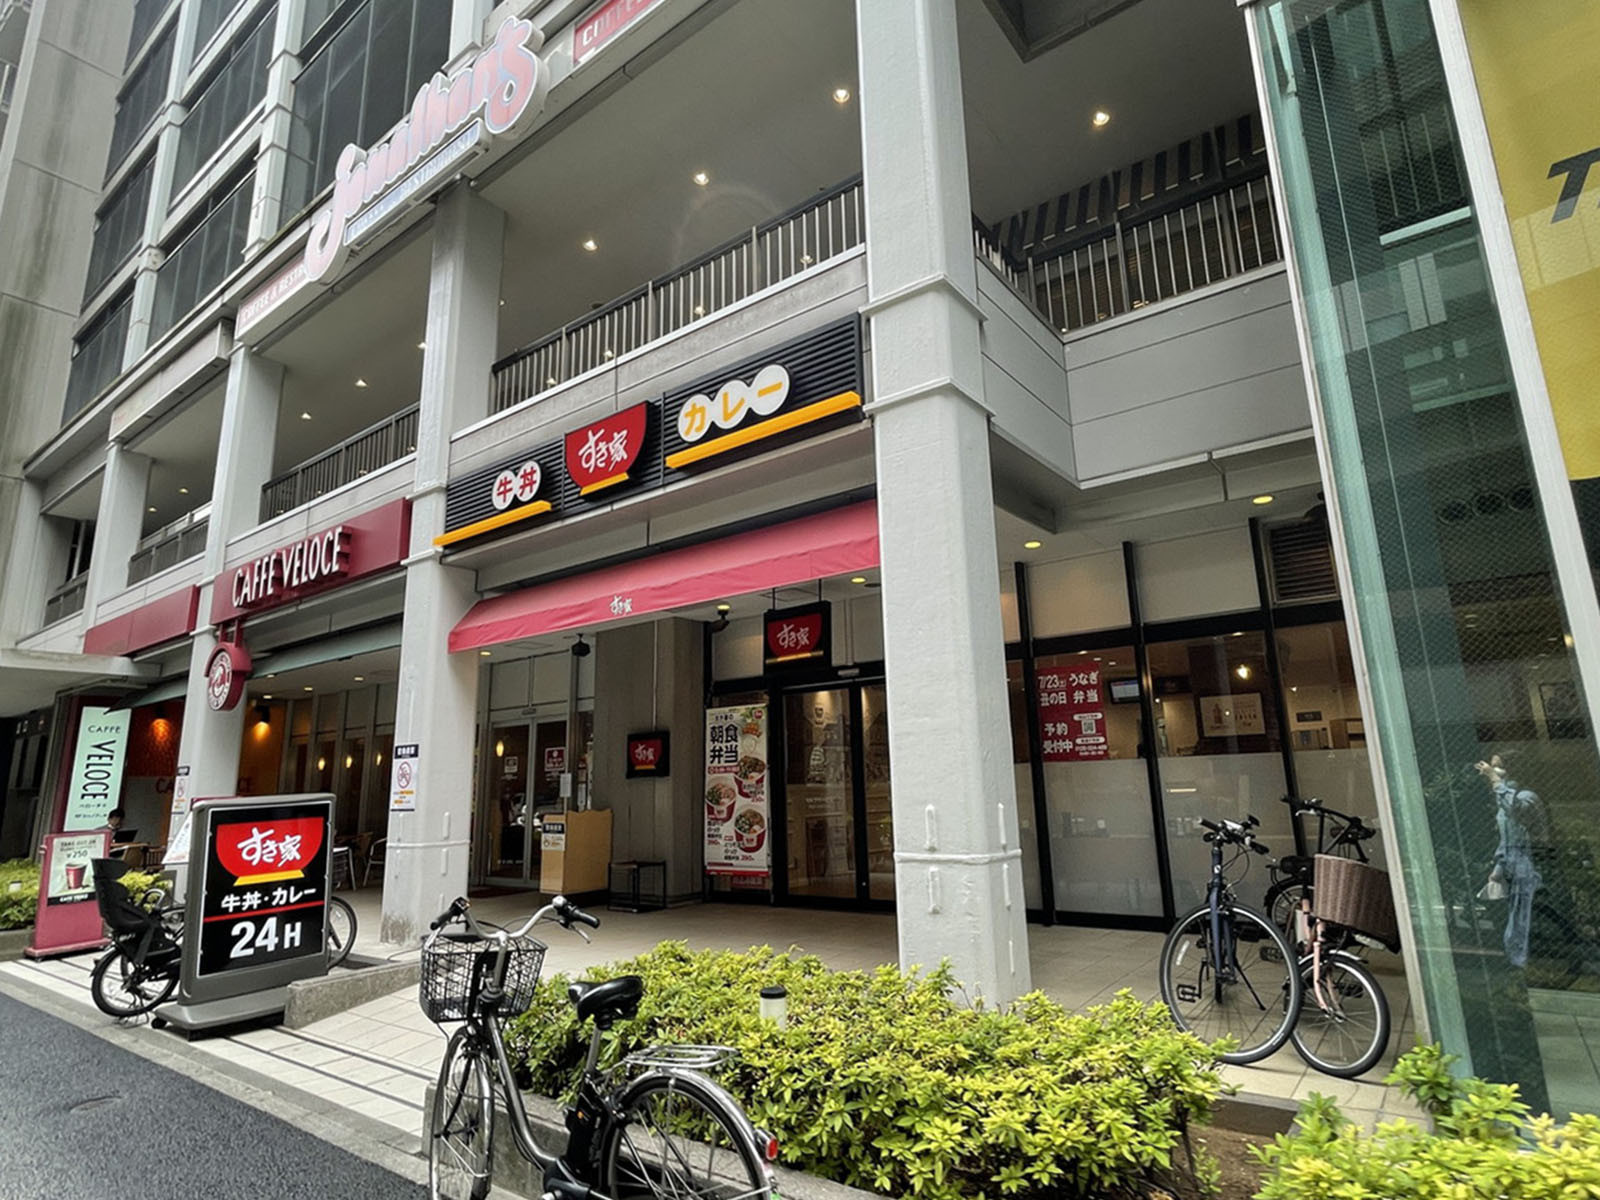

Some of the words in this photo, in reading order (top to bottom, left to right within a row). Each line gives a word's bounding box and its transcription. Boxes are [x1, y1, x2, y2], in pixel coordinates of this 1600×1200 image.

[1546, 147, 1600, 224] T
[684, 380, 783, 436] カレー
[578, 428, 629, 473] すき家
[496, 466, 538, 504] 牛丼
[232, 552, 277, 608] CAFFE
[282, 525, 343, 589] VELOCE
[609, 595, 633, 615] すき家
[777, 623, 811, 651] すき家
[1069, 670, 1099, 687] うなぎ
[1073, 688, 1099, 704] 弁当
[710, 723, 738, 744] 朝食
[1044, 722, 1068, 737] 予約
[710, 744, 738, 764] 弁当
[1043, 738, 1074, 754] 受付中
[80, 740, 117, 800] VELOCE
[237, 827, 302, 868] すき家
[221, 886, 317, 913] 牛丼・カレー
